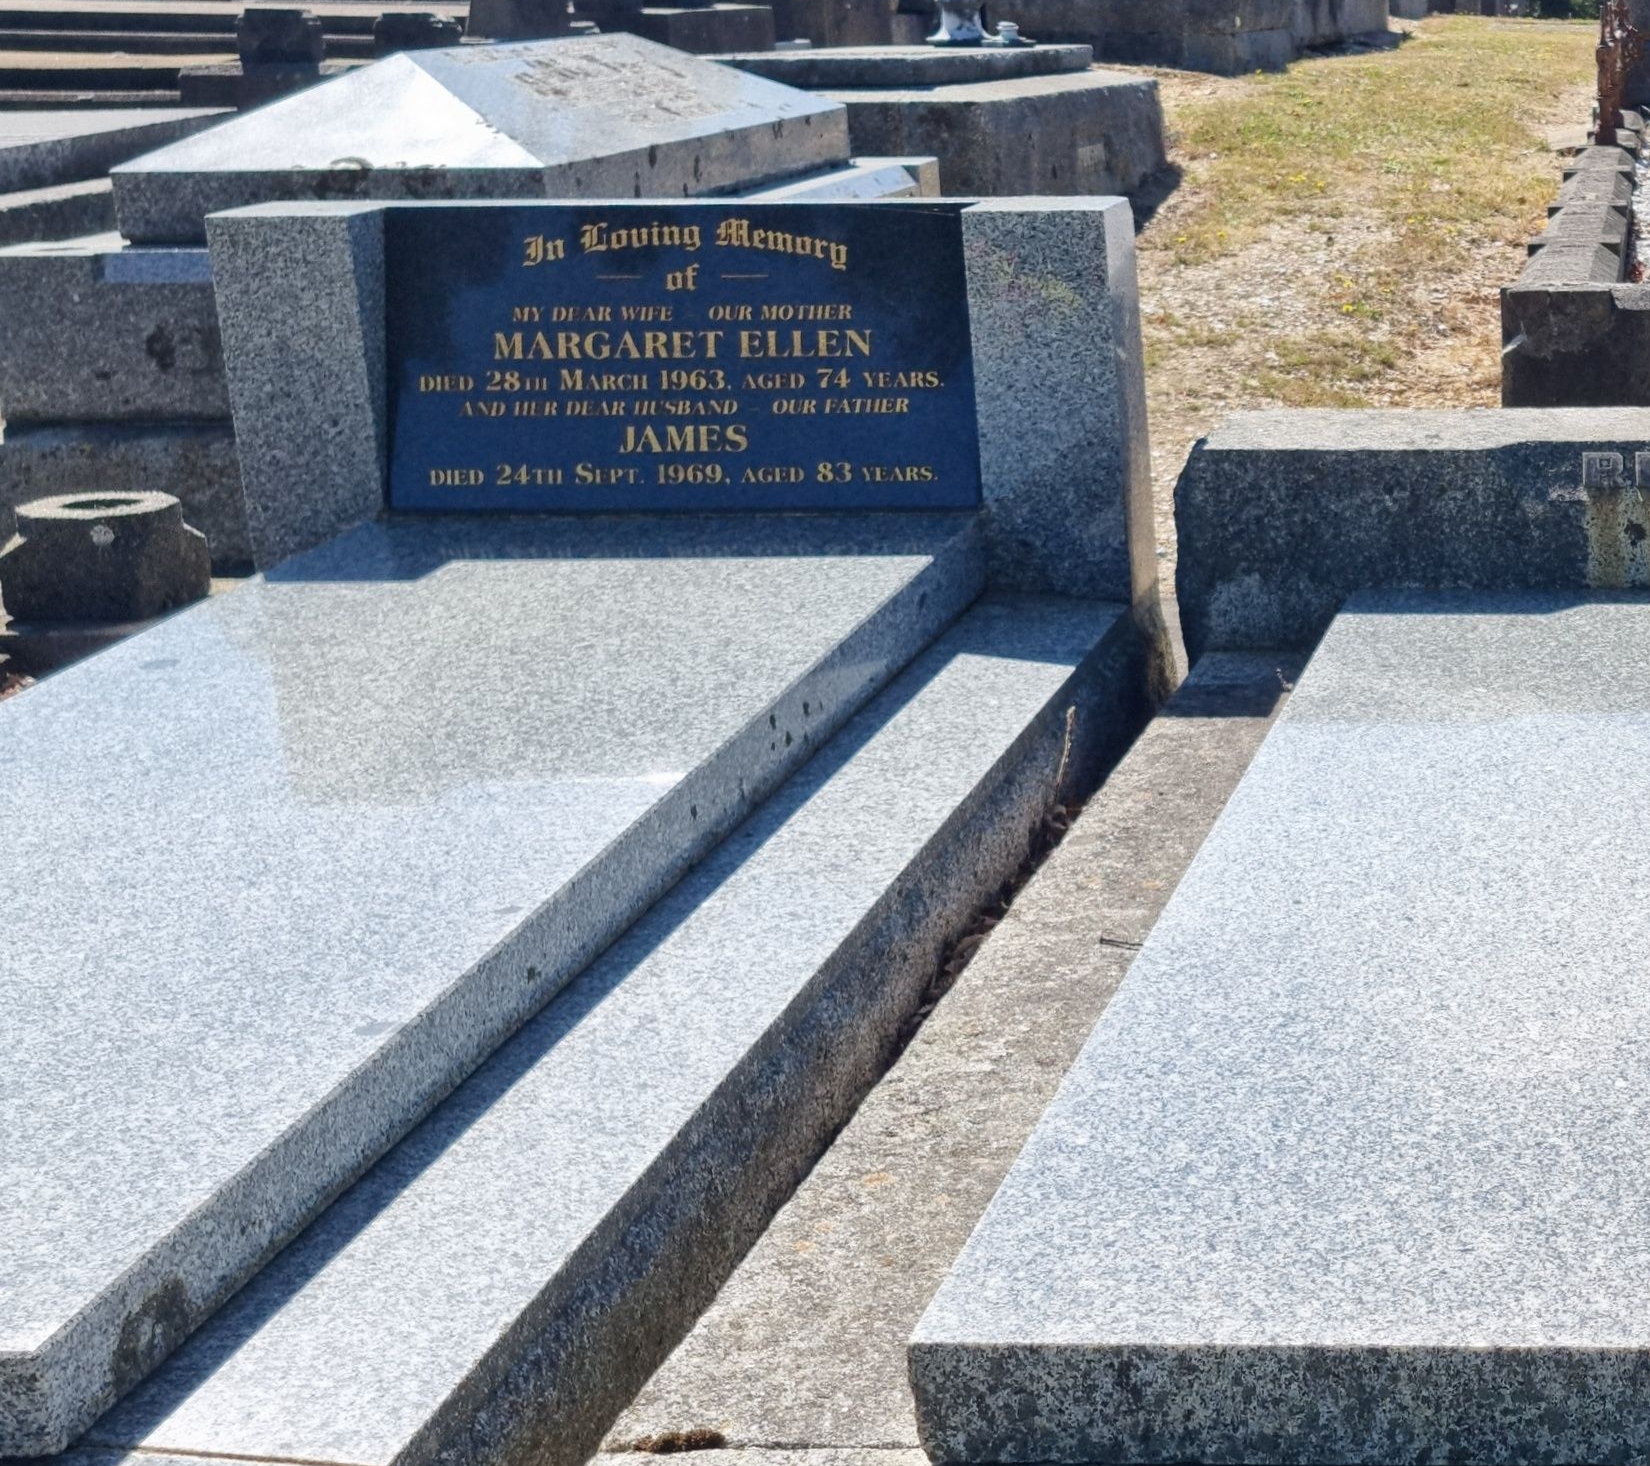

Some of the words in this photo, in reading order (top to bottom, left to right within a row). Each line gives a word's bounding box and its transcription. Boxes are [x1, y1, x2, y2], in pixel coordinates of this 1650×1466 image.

[522, 234, 565, 267] In
[579, 221, 701, 254] Loving
[715, 218, 848, 271] Memory
[665, 263, 699, 291] of
[512, 306, 544, 321] MY
[552, 306, 612, 321] DEAR
[621, 305, 674, 321] WIFE
[708, 305, 752, 320] OUR
[761, 304, 852, 320] MOTHER
[493, 330, 724, 360] MARGARET
[739, 329, 872, 358] ELLEN
[419, 375, 474, 392] DIED
[742, 373, 805, 390] AGED
[816, 368, 850, 388] 74
[862, 371, 945, 388] YEARS.
[459, 401, 506, 417] AND
[513, 401, 557, 416] HER
[566, 400, 626, 416] DEAR
[634, 400, 738, 416] HUSBAND
[772, 399, 816, 414] OUR
[824, 398, 909, 413] FATHER
[618, 424, 748, 453] JAMES
[430, 469, 484, 485] DIED
[496, 464, 562, 484] 24TH
[657, 463, 731, 486] 1969,
[741, 467, 805, 483] AGED
[816, 462, 852, 482] 83
[862, 466, 938, 482] YEARS.
